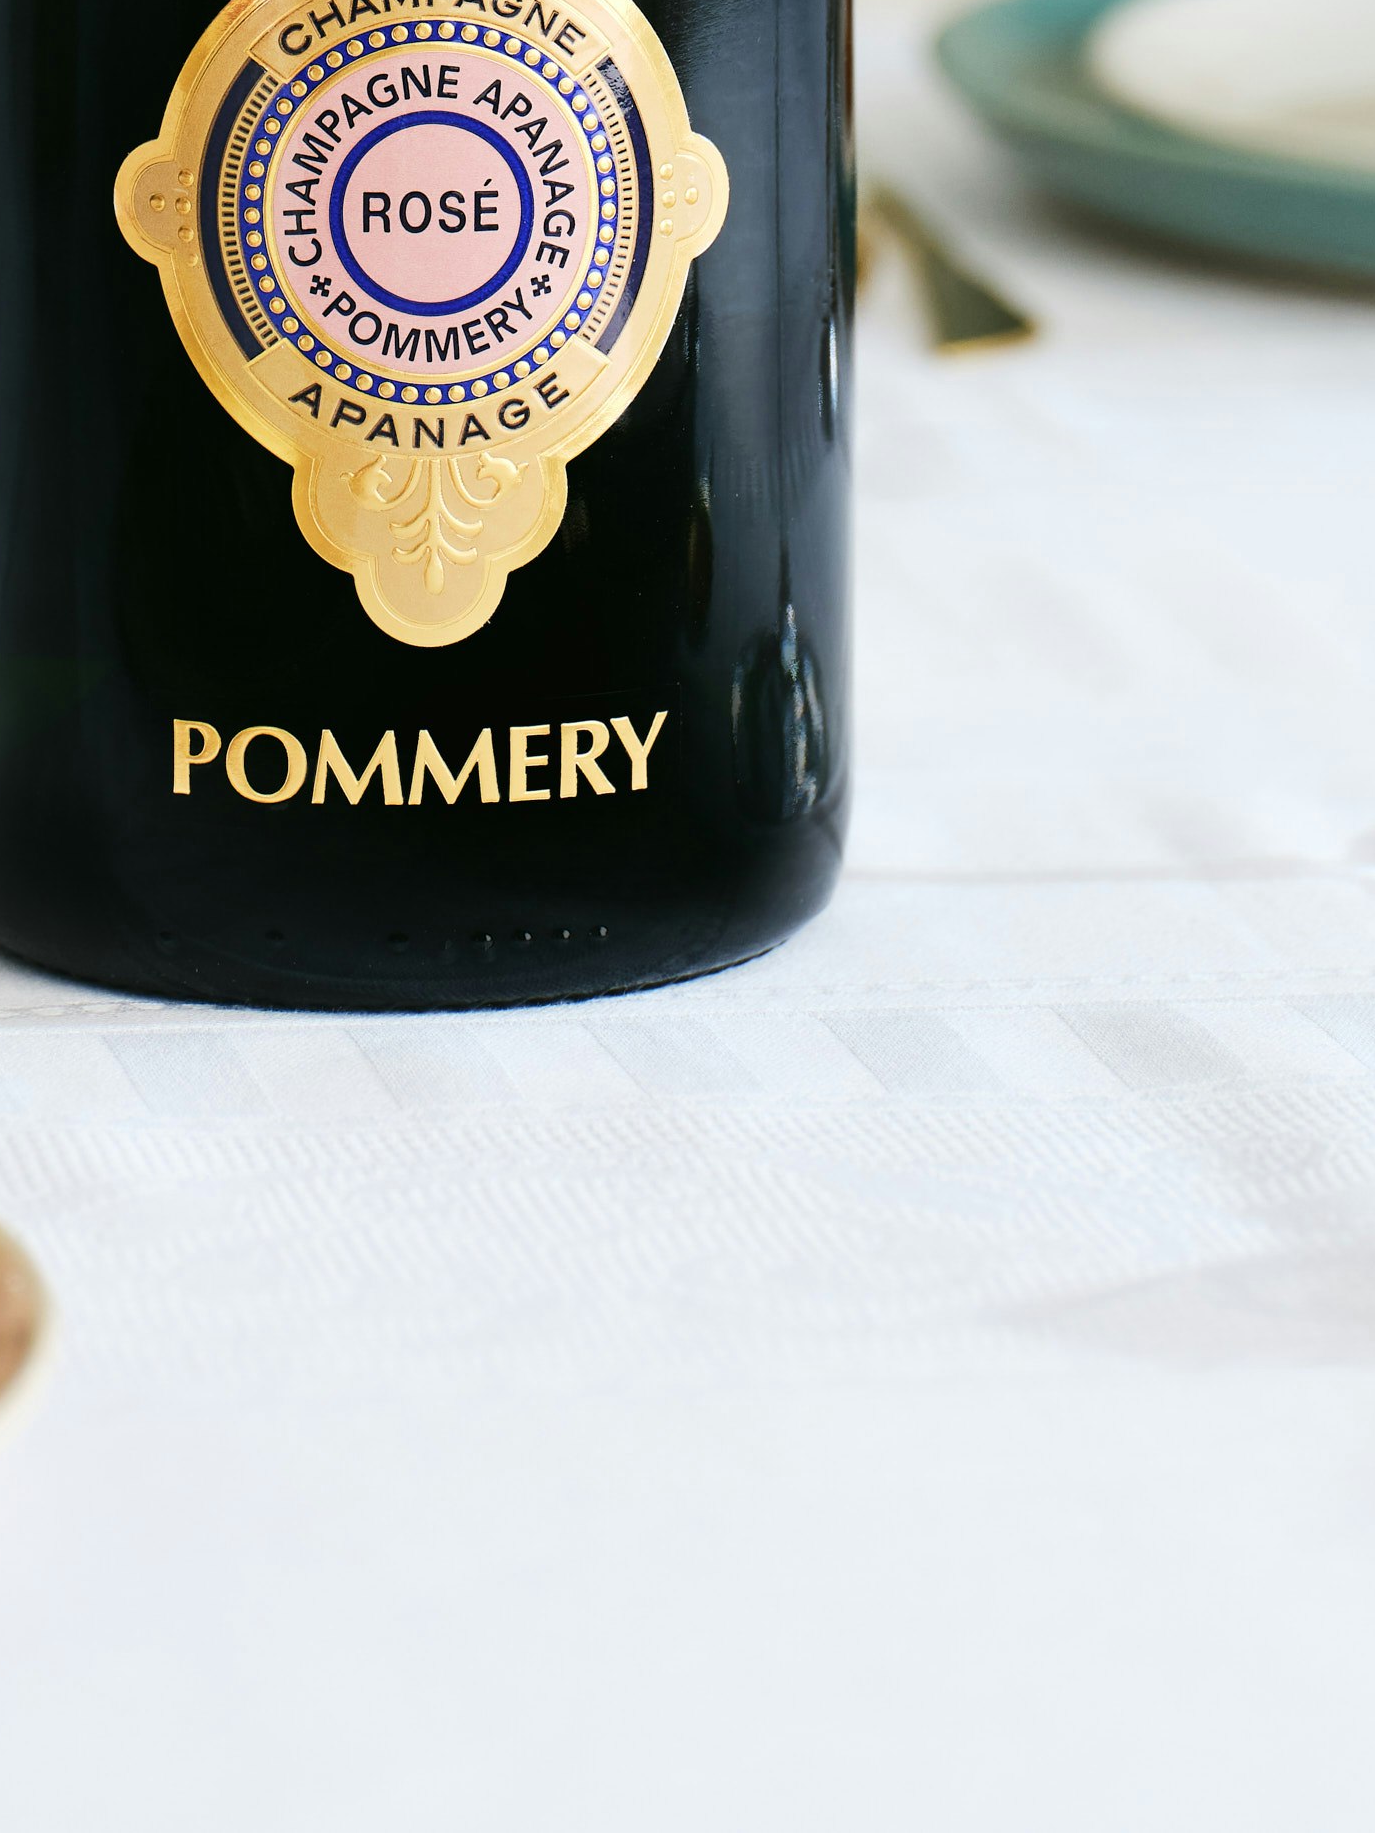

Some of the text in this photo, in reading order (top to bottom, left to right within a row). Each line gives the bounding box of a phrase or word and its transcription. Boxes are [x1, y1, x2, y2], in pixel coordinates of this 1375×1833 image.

[283, 64, 576, 269] CHAMPAGNE APANAGE
[361, 178, 500, 234] ROSÉ
[322, 288, 534, 363] POMMERY
[287, 371, 571, 449] APANAGE
[173, 710, 669, 806] POMMERY
